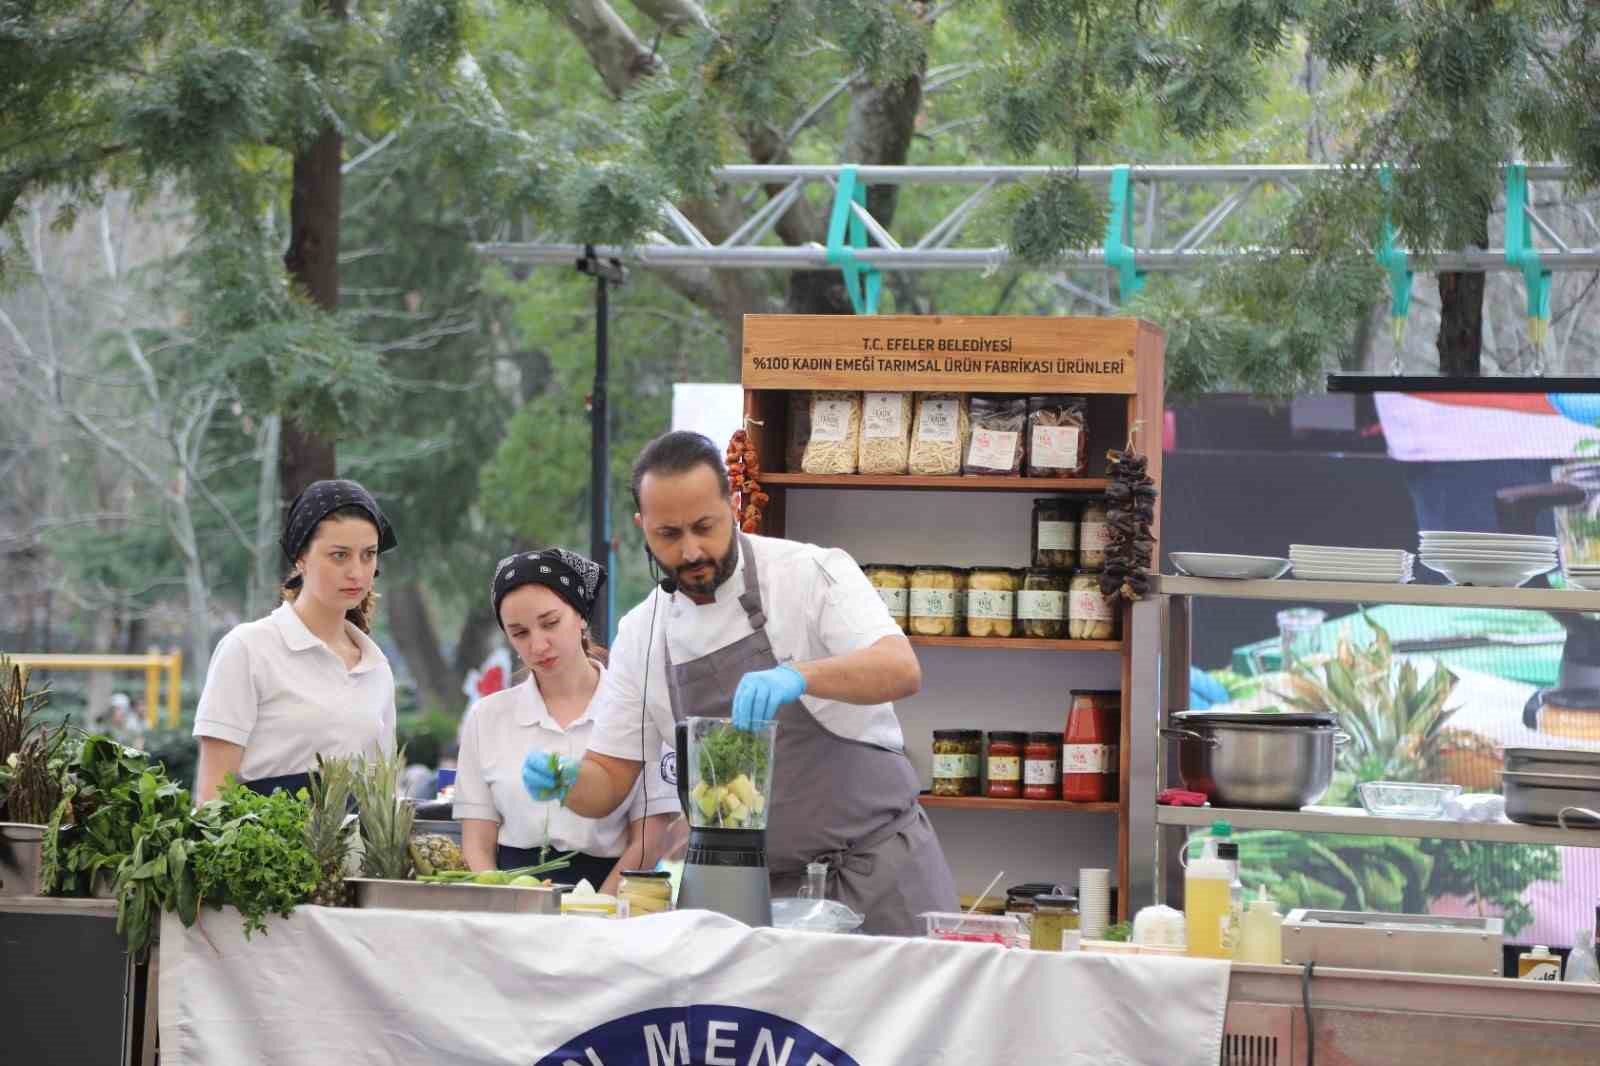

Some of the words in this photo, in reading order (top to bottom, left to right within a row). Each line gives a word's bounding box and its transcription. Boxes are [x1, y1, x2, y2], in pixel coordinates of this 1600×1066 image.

[862, 338, 883, 350] T.C.
[887, 338, 934, 351] EFELER
[938, 337, 1012, 352] BELEDİYESİ
[753, 357, 789, 370] %100
[793, 358, 832, 371] KADIN
[836, 356, 875, 372] EMEĞİ
[878, 359, 941, 373] TARIMSAL
[945, 357, 981, 373] ÜRÜN
[985, 357, 1052, 374] FABRİKASI
[1057, 358, 1124, 375] ÜRÜNLERİ
